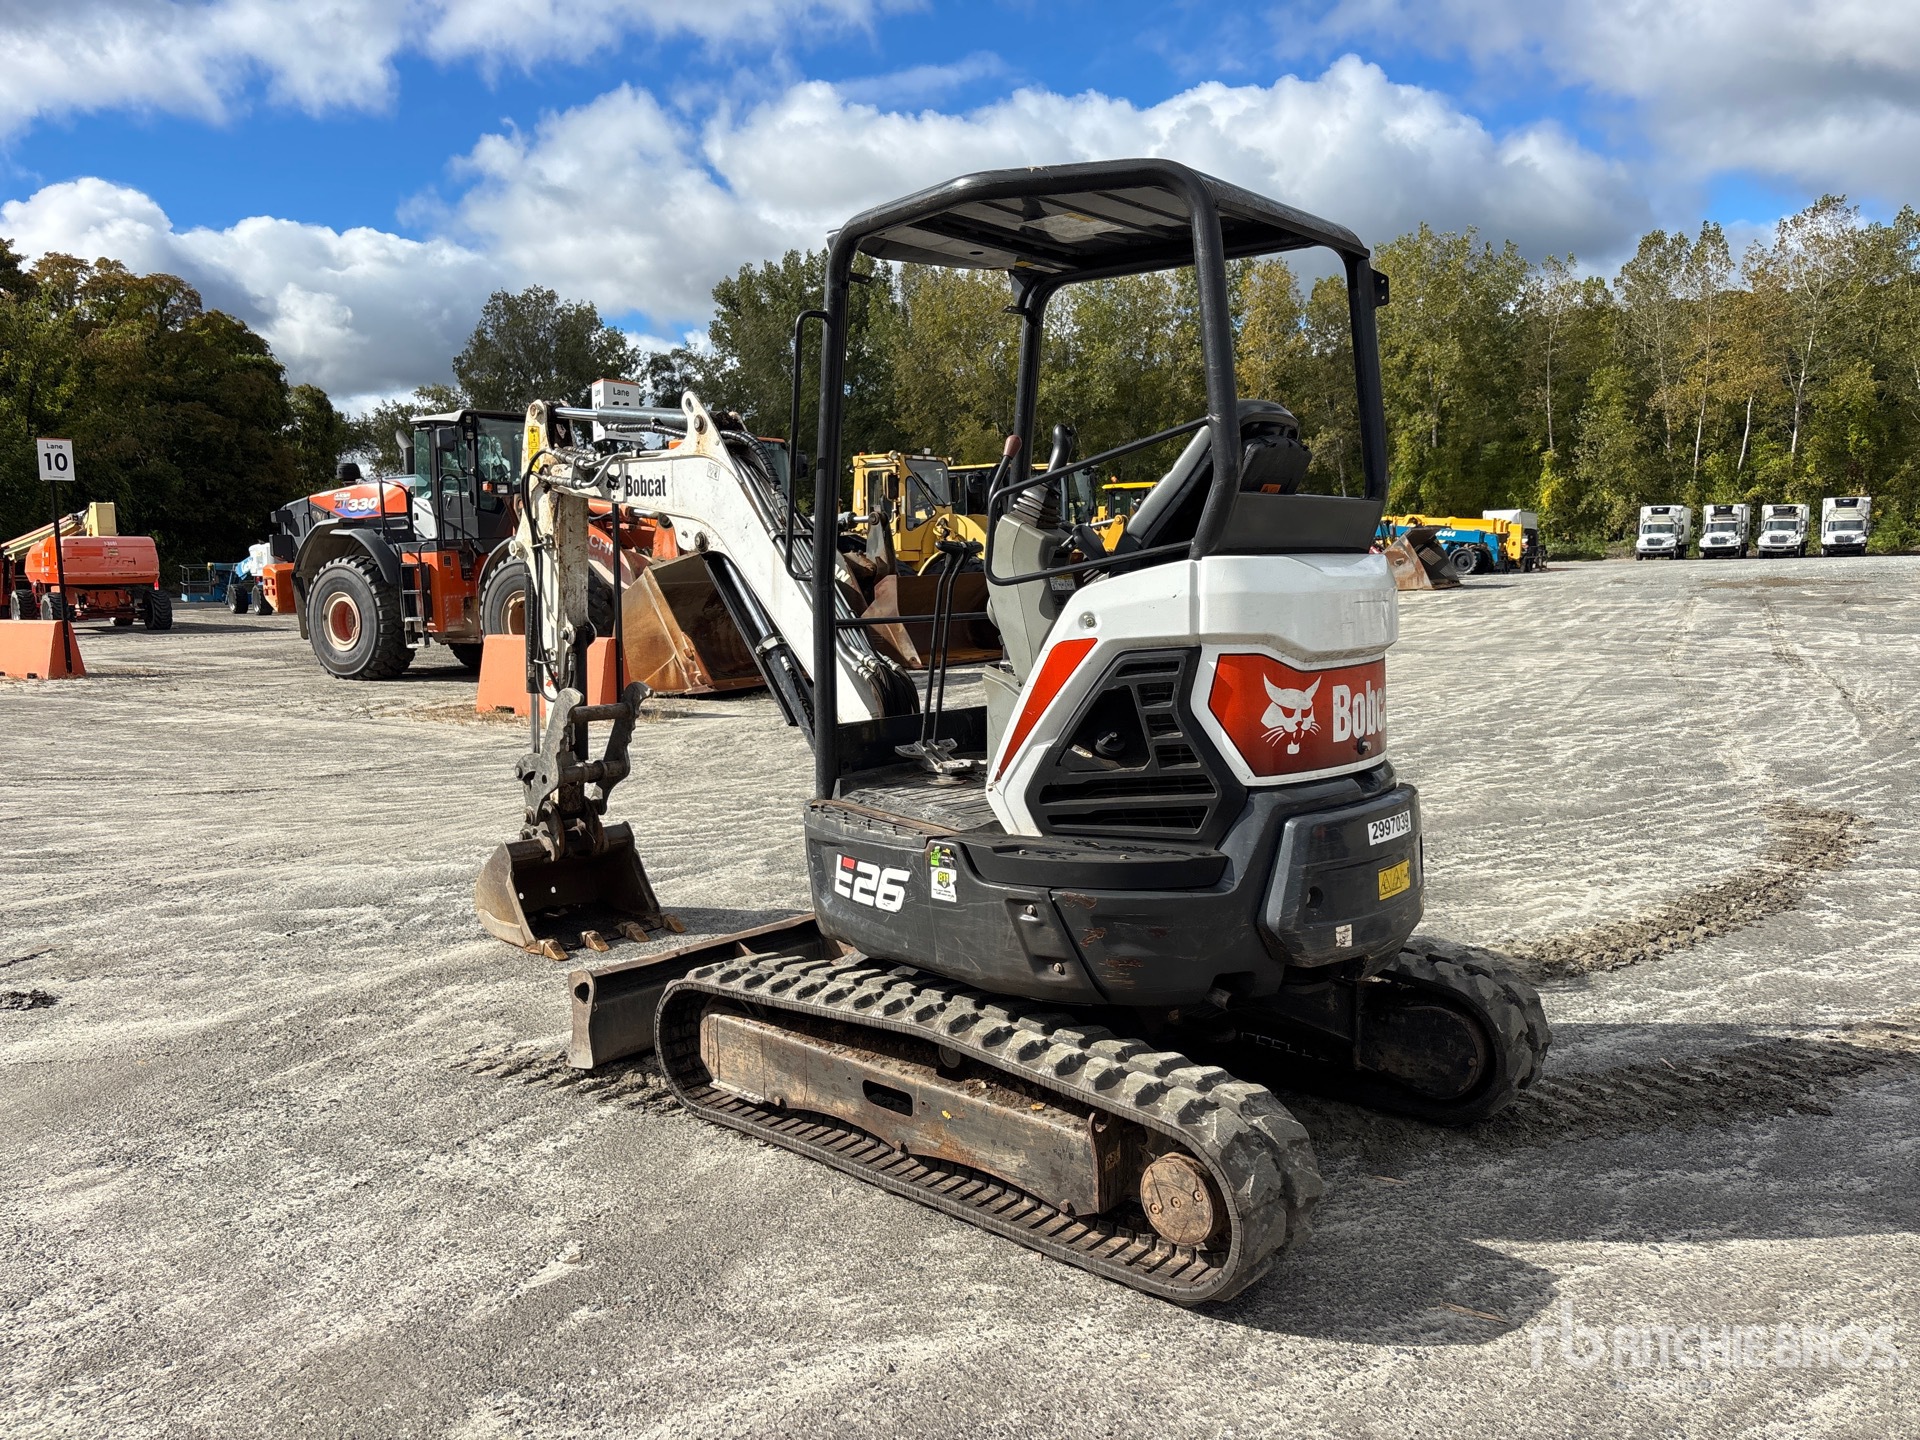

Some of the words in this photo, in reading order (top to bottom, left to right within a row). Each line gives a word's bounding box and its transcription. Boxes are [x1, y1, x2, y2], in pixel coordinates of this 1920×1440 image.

[613, 386, 630, 397] Lane
[46, 442, 63, 450] Lane
[43, 452, 68, 472] 10
[625, 474, 667, 497] Bobcat
[1371, 812, 1409, 840] 2997039
[834, 854, 911, 912] E26
[938, 871, 949, 884] 811
